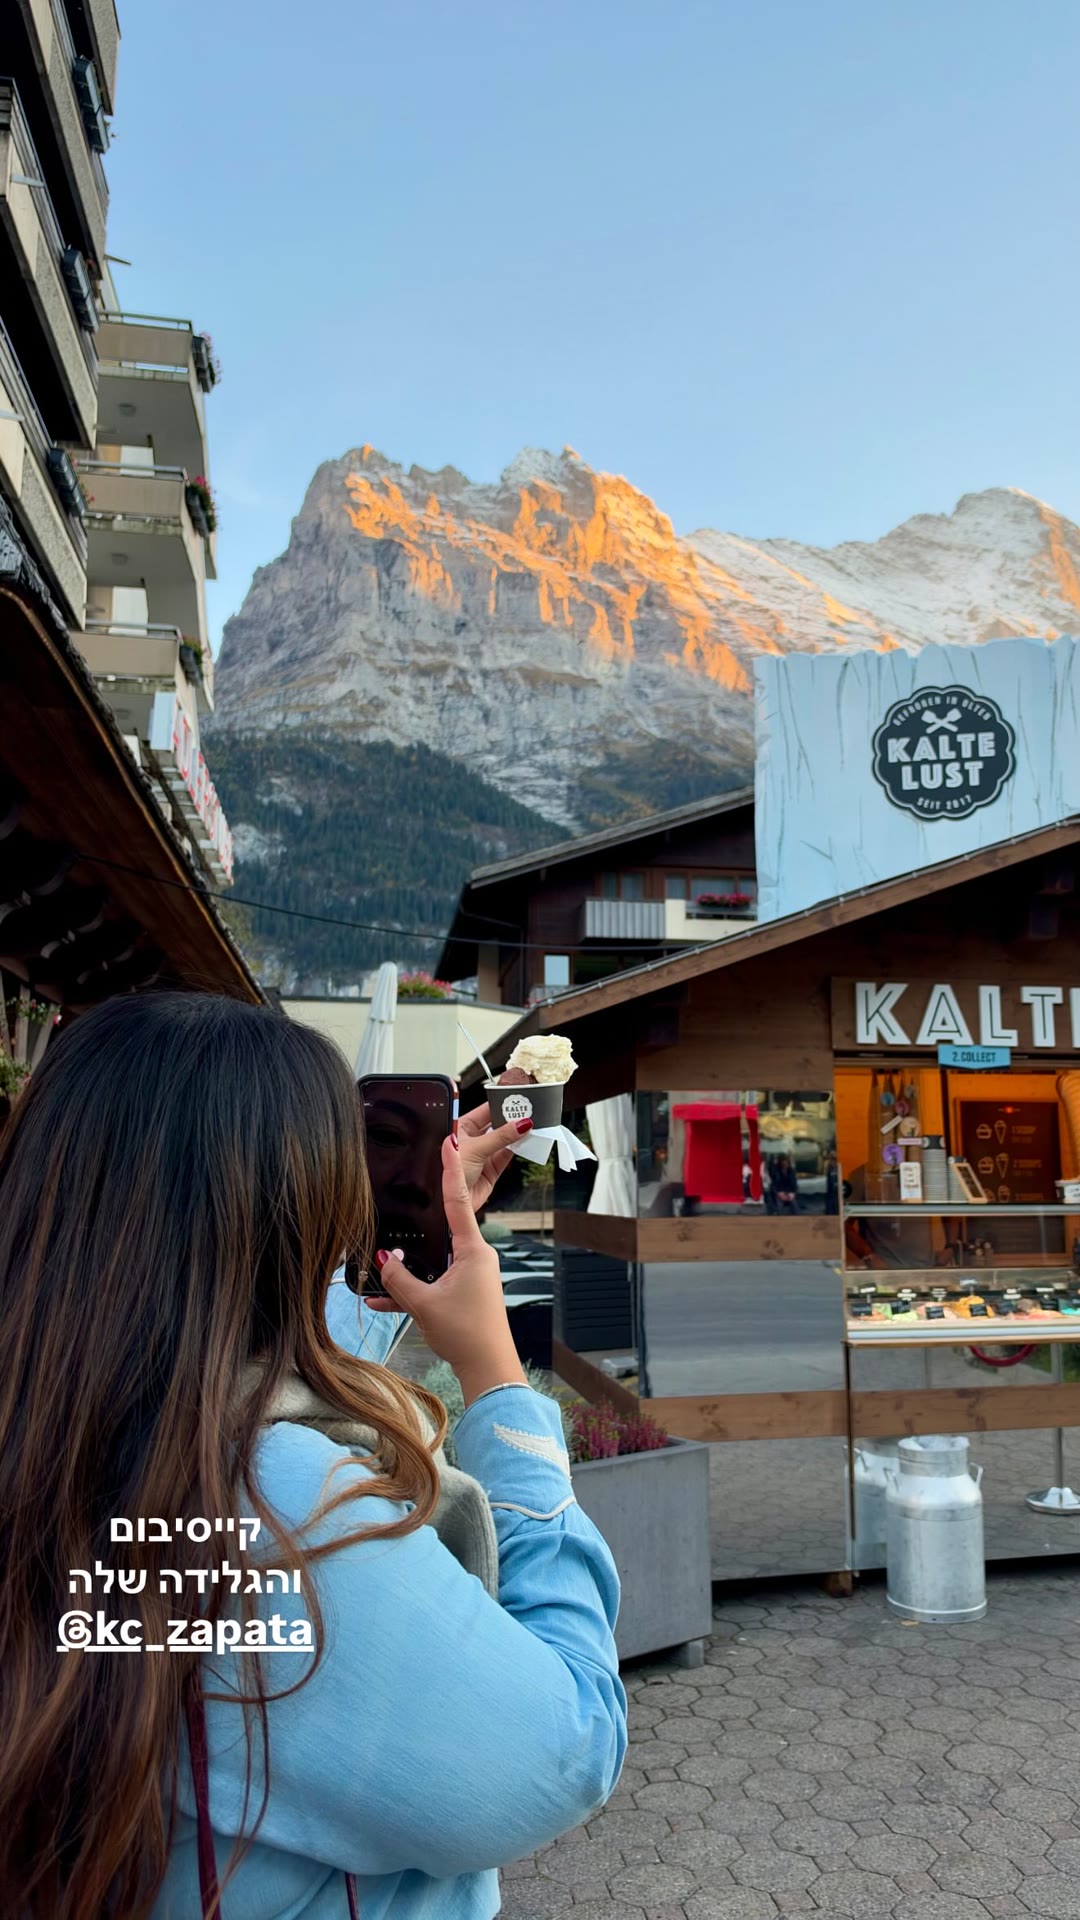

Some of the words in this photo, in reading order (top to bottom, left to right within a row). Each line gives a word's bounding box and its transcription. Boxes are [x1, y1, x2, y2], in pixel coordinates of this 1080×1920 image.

[946, 696, 957, 705] IN
[962, 699, 991, 721] OLTEN
[887, 732, 996, 763] KALTE
[901, 761, 983, 791] LUST
[917, 797, 941, 810] SEIT
[946, 794, 972, 810] 2017
